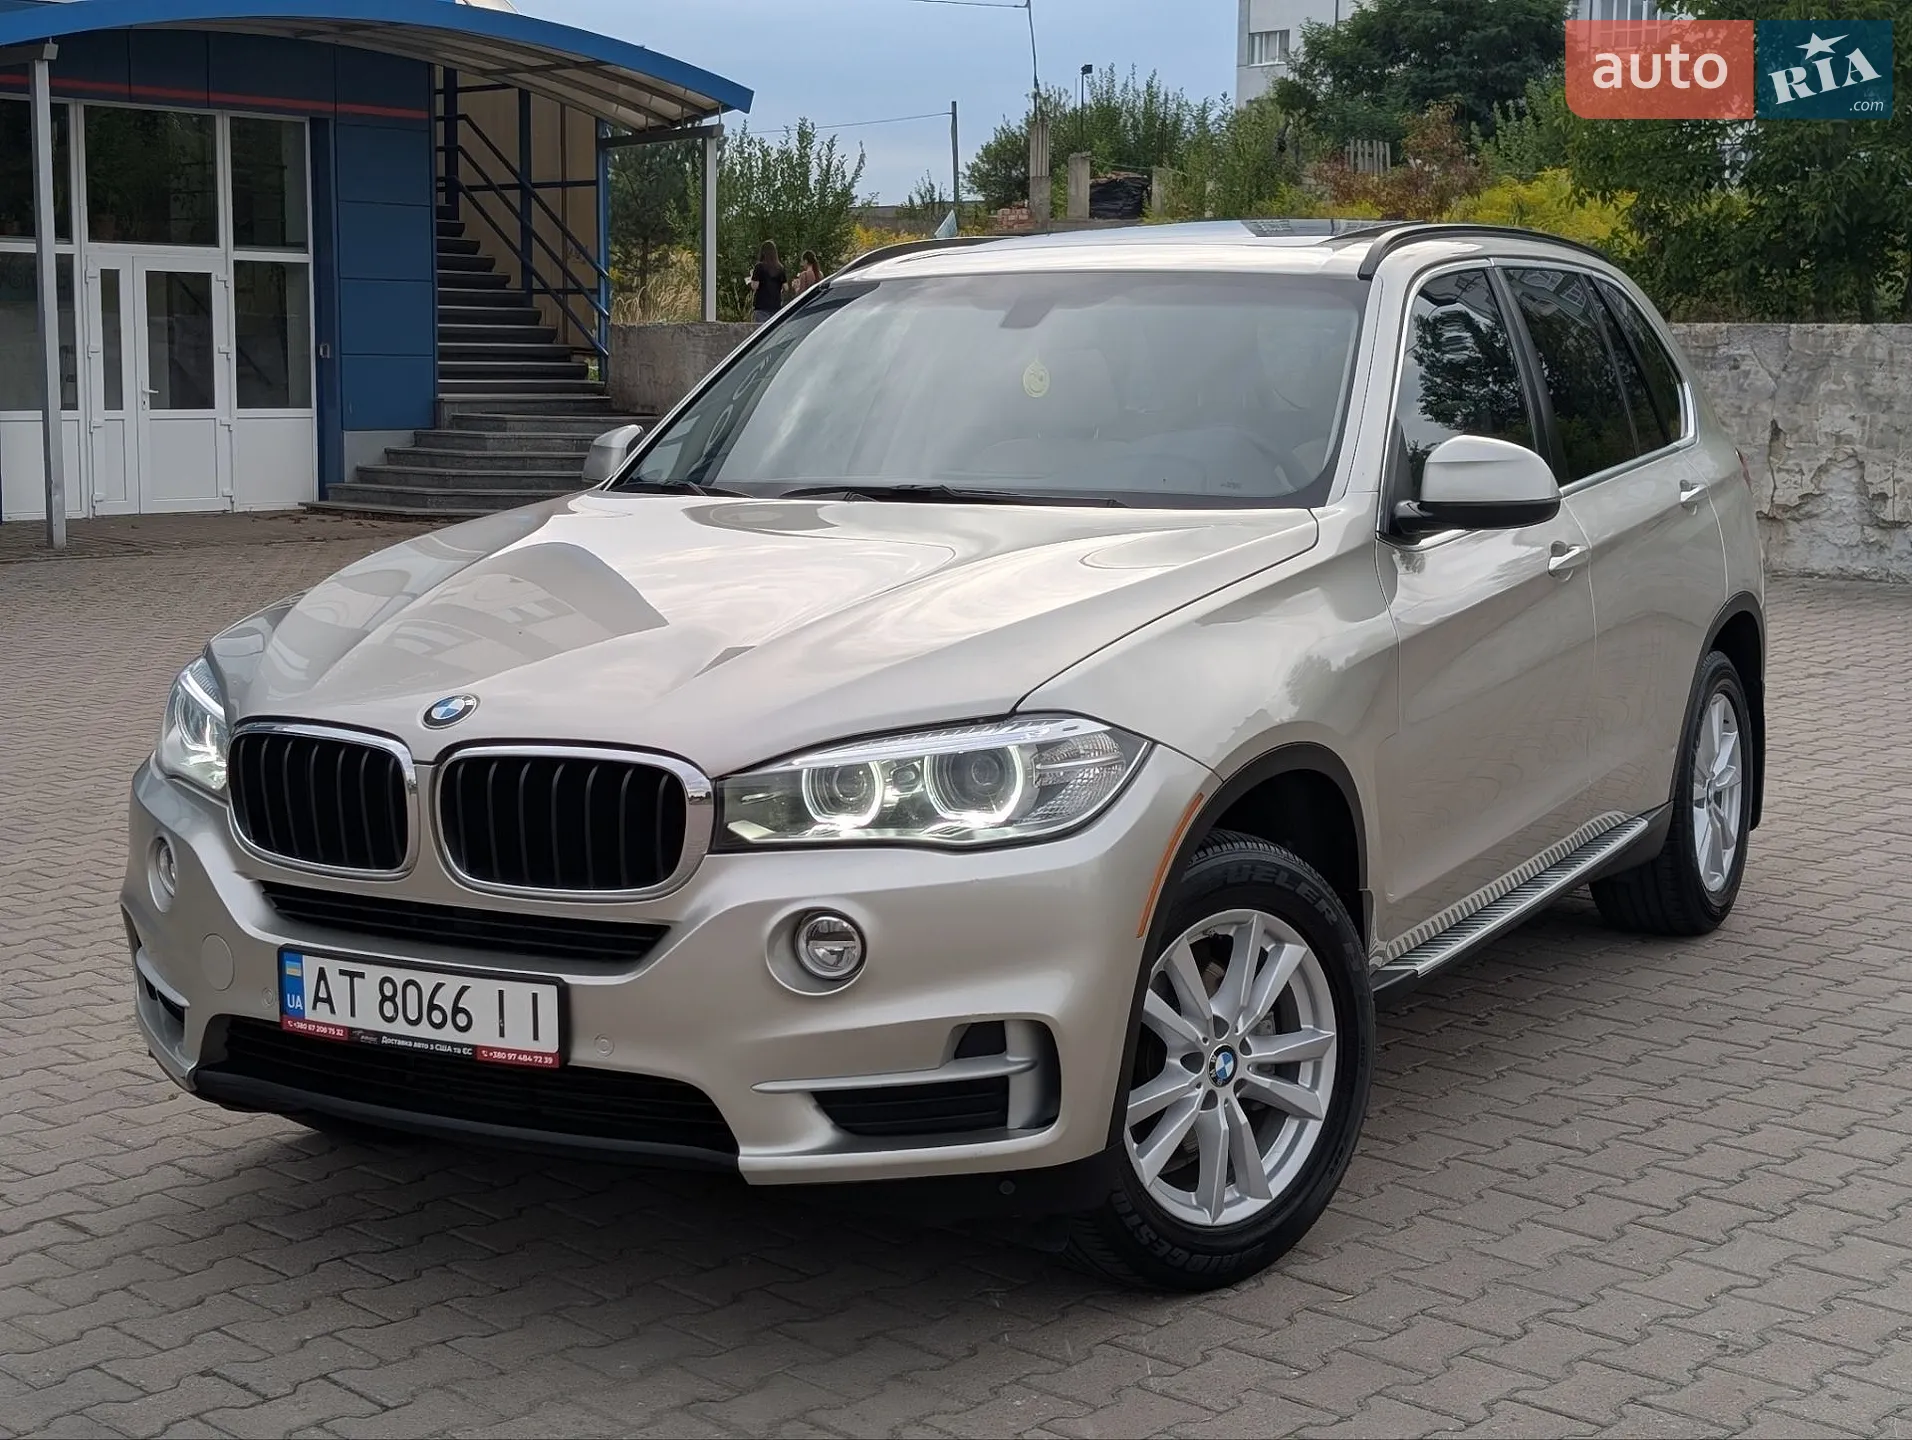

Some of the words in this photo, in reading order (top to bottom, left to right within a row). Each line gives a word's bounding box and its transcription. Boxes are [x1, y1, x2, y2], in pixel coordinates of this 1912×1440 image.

[287, 993, 303, 1010] UA
[311, 966, 366, 1018] AT
[378, 975, 473, 1034] 8066
[381, 1036, 412, 1047] Доставка
[413, 1041, 429, 1050] авто
[435, 1044, 452, 1053] США
[489, 1051, 506, 1060] +380
